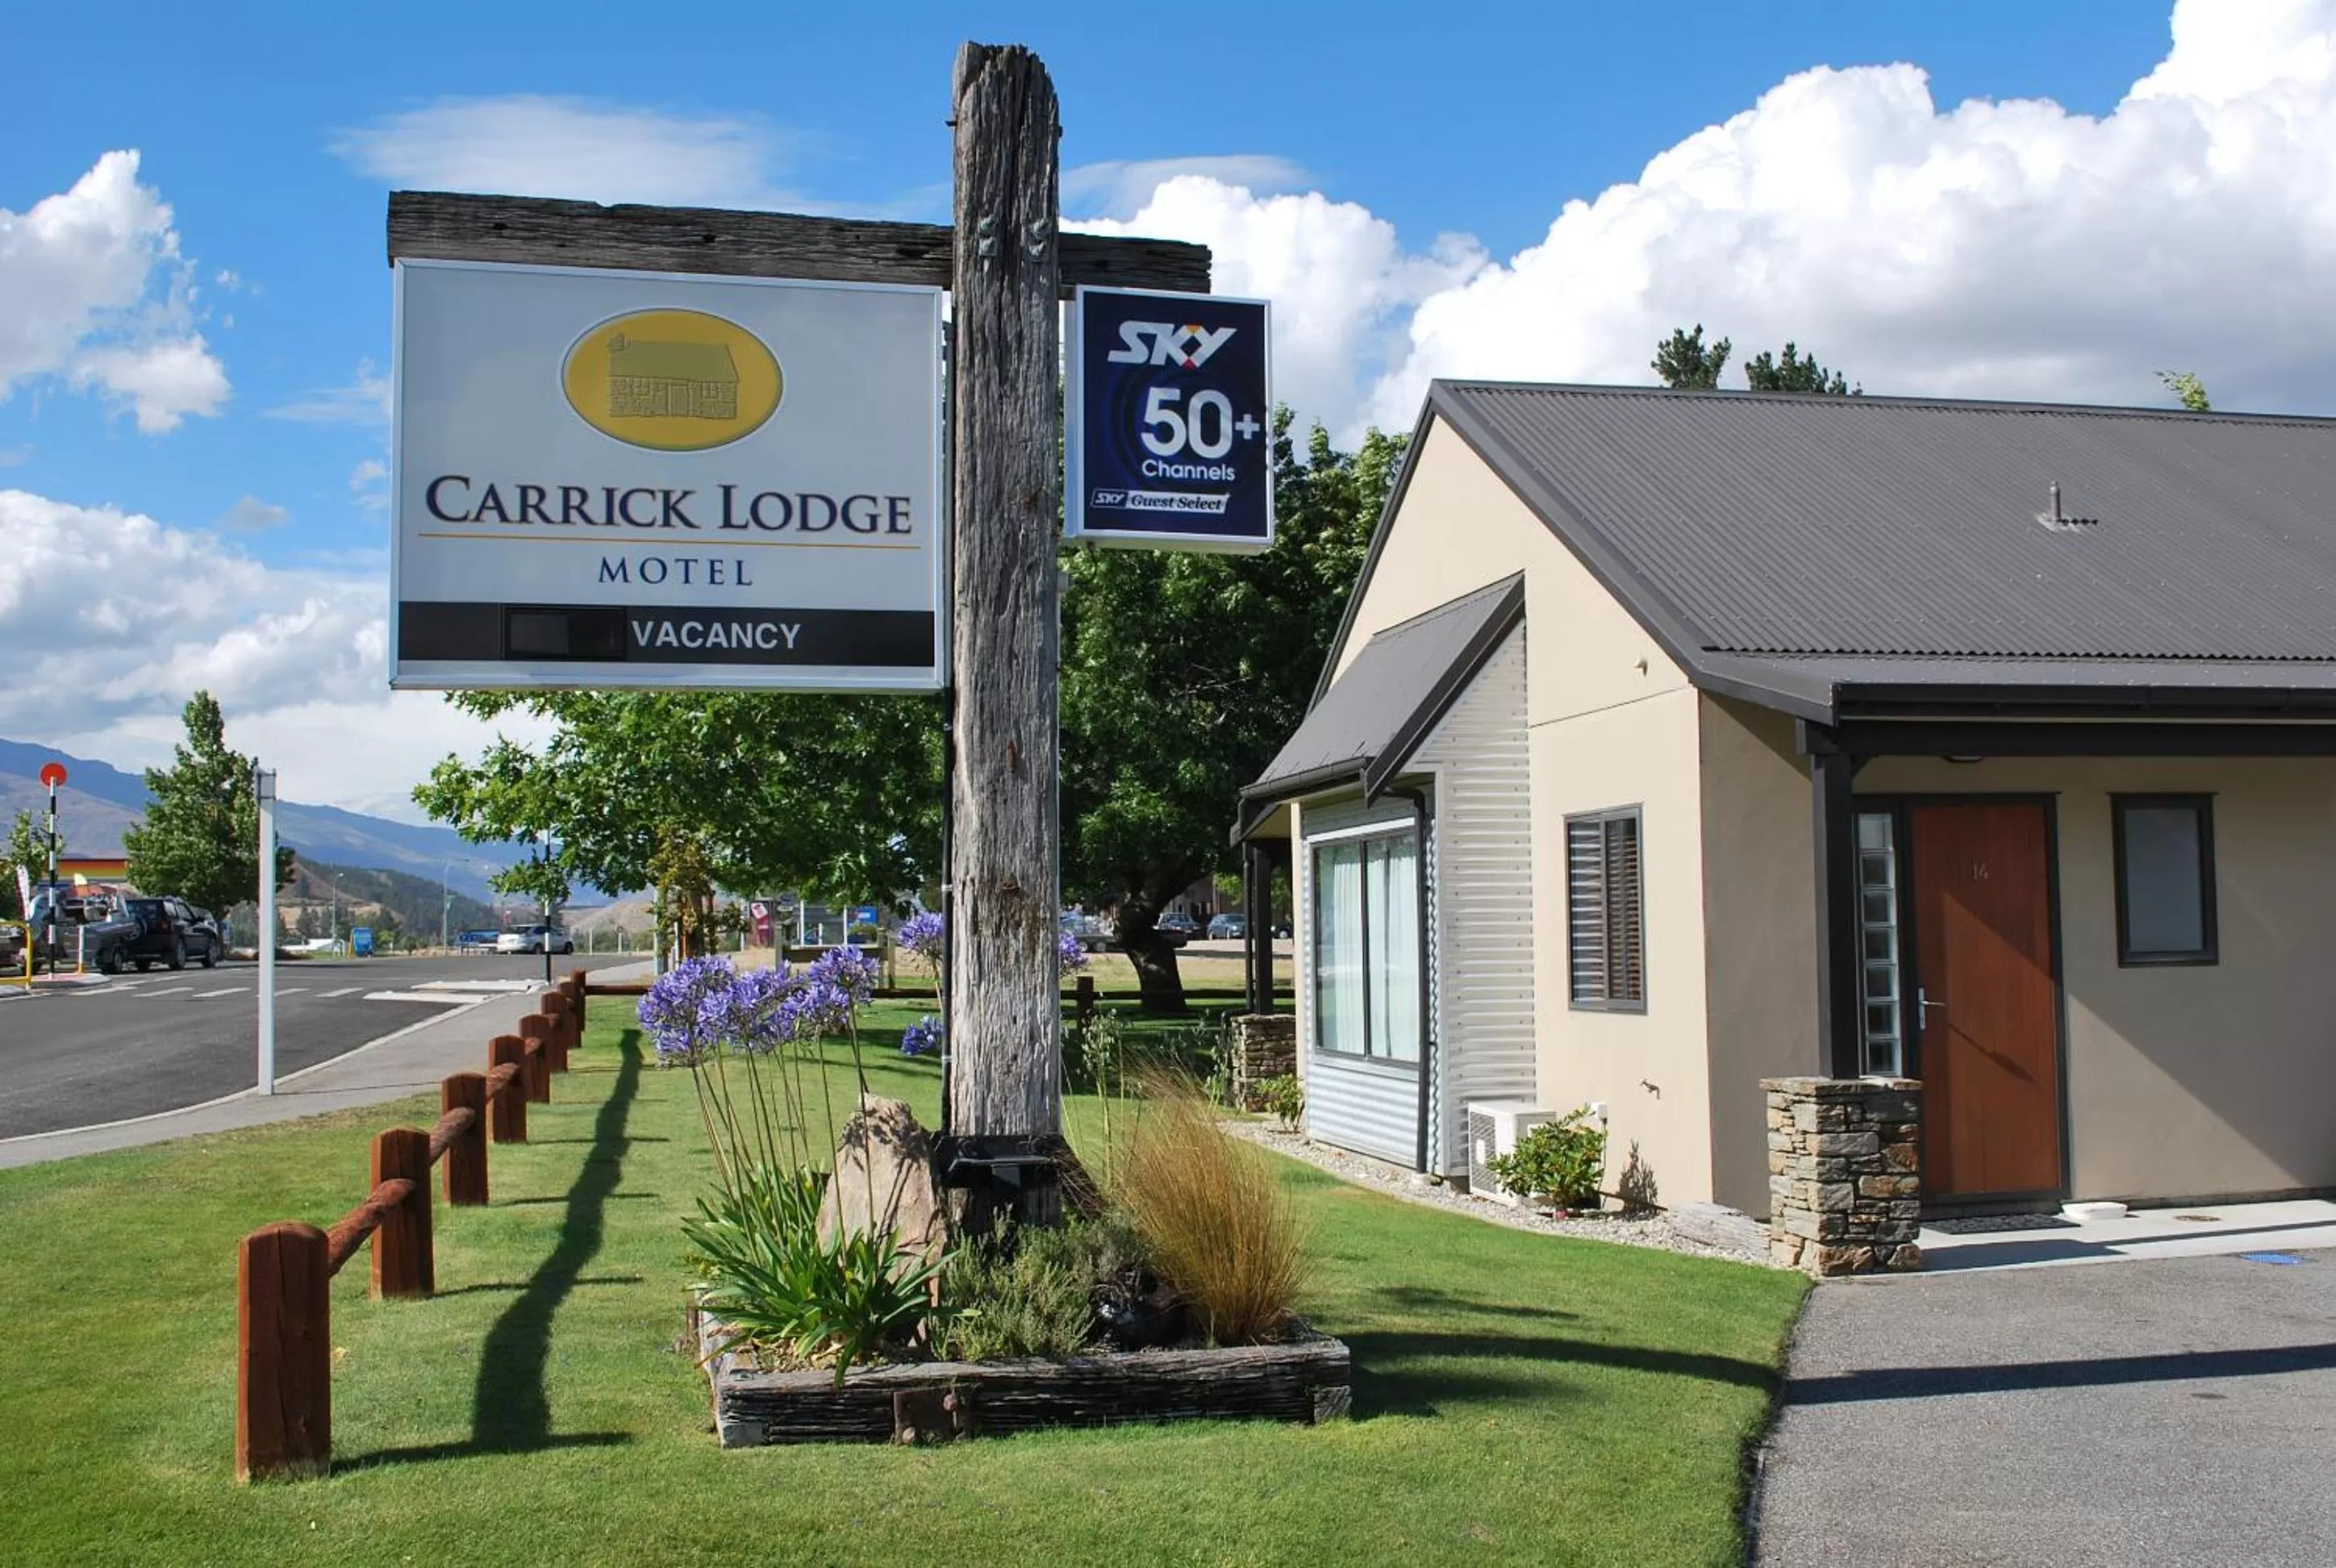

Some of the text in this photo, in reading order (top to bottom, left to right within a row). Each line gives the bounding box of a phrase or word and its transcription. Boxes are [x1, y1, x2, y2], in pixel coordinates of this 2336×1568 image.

[1107, 320, 1238, 371] SKY
[1141, 386, 1261, 459] 50+
[1141, 458, 1236, 481] Channels
[425, 474, 912, 535] CARRICK LODGE
[1095, 492, 1222, 511] SKY Guest Select
[598, 556, 753, 586] MOTEL
[632, 619, 801, 649] VACANCY
